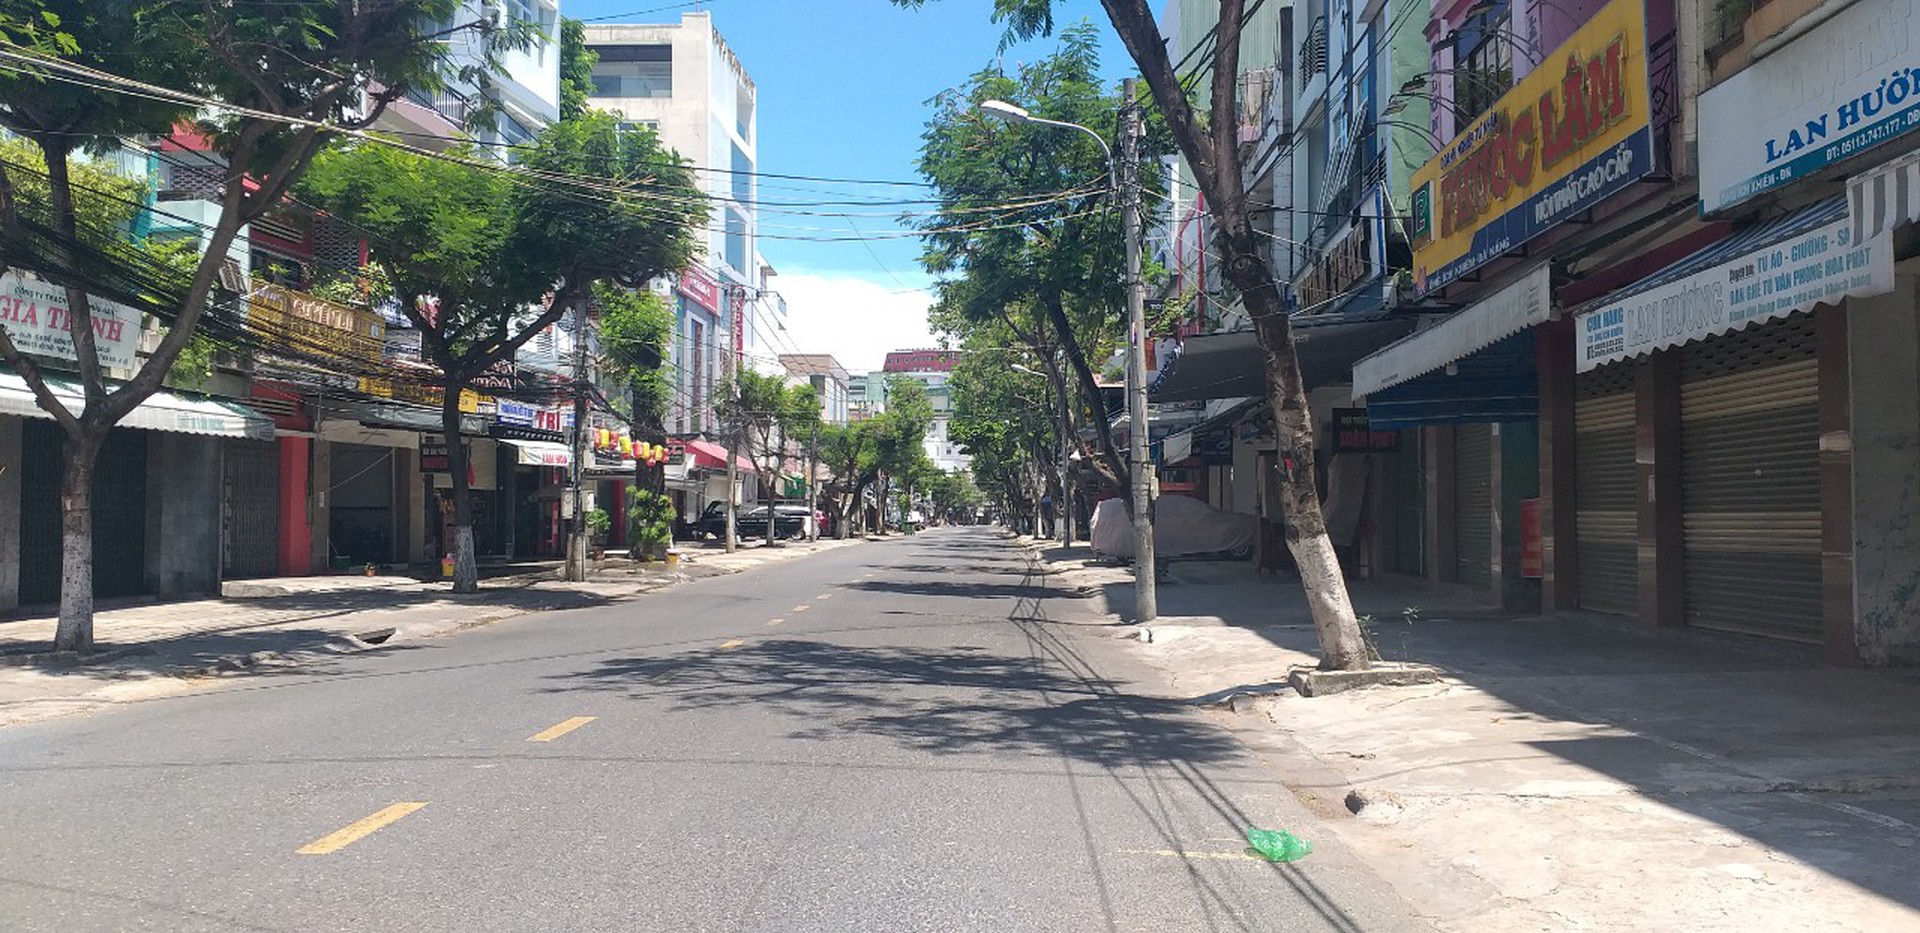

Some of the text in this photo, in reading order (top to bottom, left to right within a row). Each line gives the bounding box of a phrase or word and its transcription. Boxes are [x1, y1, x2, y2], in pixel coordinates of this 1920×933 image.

[1538, 33, 1631, 171] LÂM
[1764, 114, 1828, 163] LAN
[1577, 166, 1605, 198] CAO
[1605, 142, 1633, 182] CẤP
[1791, 234, 1828, 263] GIƯỜNG
[48, 305, 124, 342] THNH
